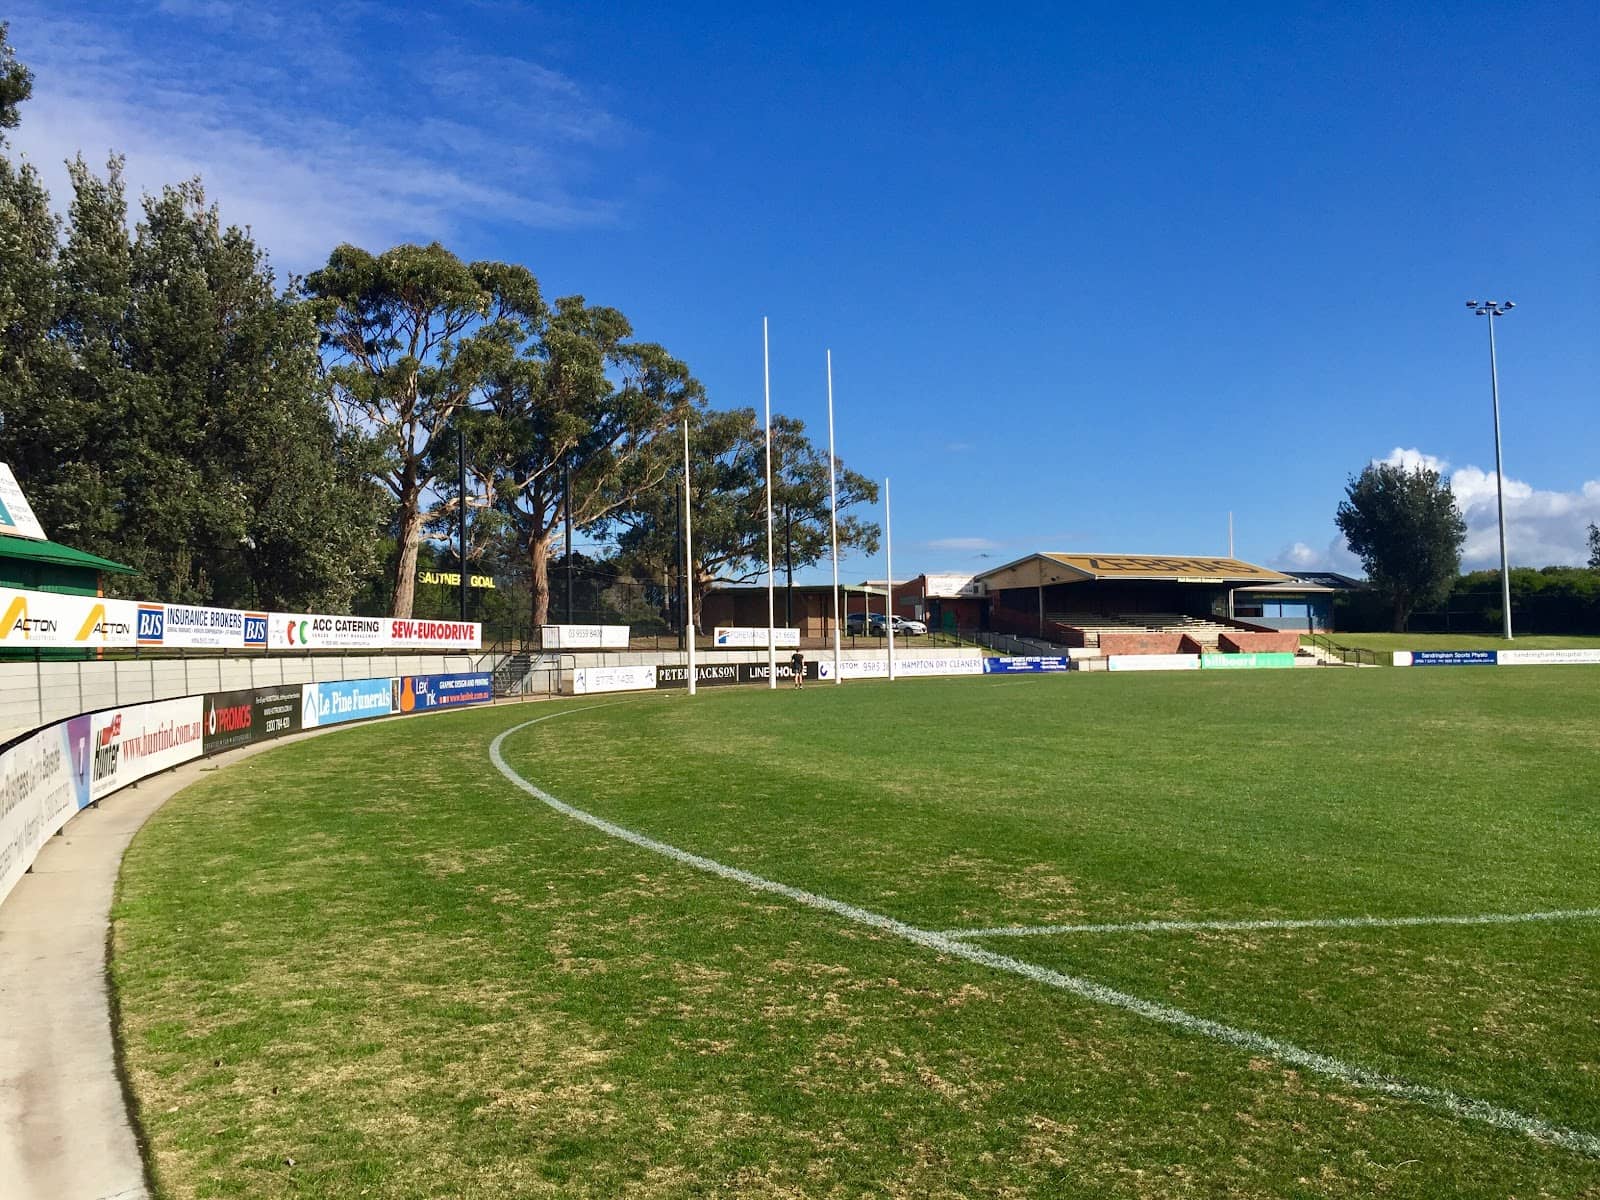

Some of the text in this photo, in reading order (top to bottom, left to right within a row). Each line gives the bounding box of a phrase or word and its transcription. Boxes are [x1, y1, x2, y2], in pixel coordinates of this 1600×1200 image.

[470, 576, 496, 588] GOAL
[13, 618, 57, 632] ACTON
[140, 613, 162, 636] BJS
[167, 608, 241, 628] INSURANCE BROKERS
[312, 619, 379, 632] ACC CATERING
[93, 623, 130, 634] ACTON
[246, 620, 265, 640] BJS
[391, 620, 475, 640] SEW-EURODRIVE
[750, 665, 807, 678] LINE HOUE
[901, 660, 933, 670] HAMPTON
[936, 660, 947, 669] DRY
[950, 658, 981, 668] CLEANERS
[694, 666, 735, 681] JACKSON
[319, 694, 330, 716] Le
[332, 692, 352, 712] Pine
[353, 688, 390, 710] Funerals
[123, 718, 200, 761] www.huntind.com.au
[93, 729, 120, 782] Hunter
